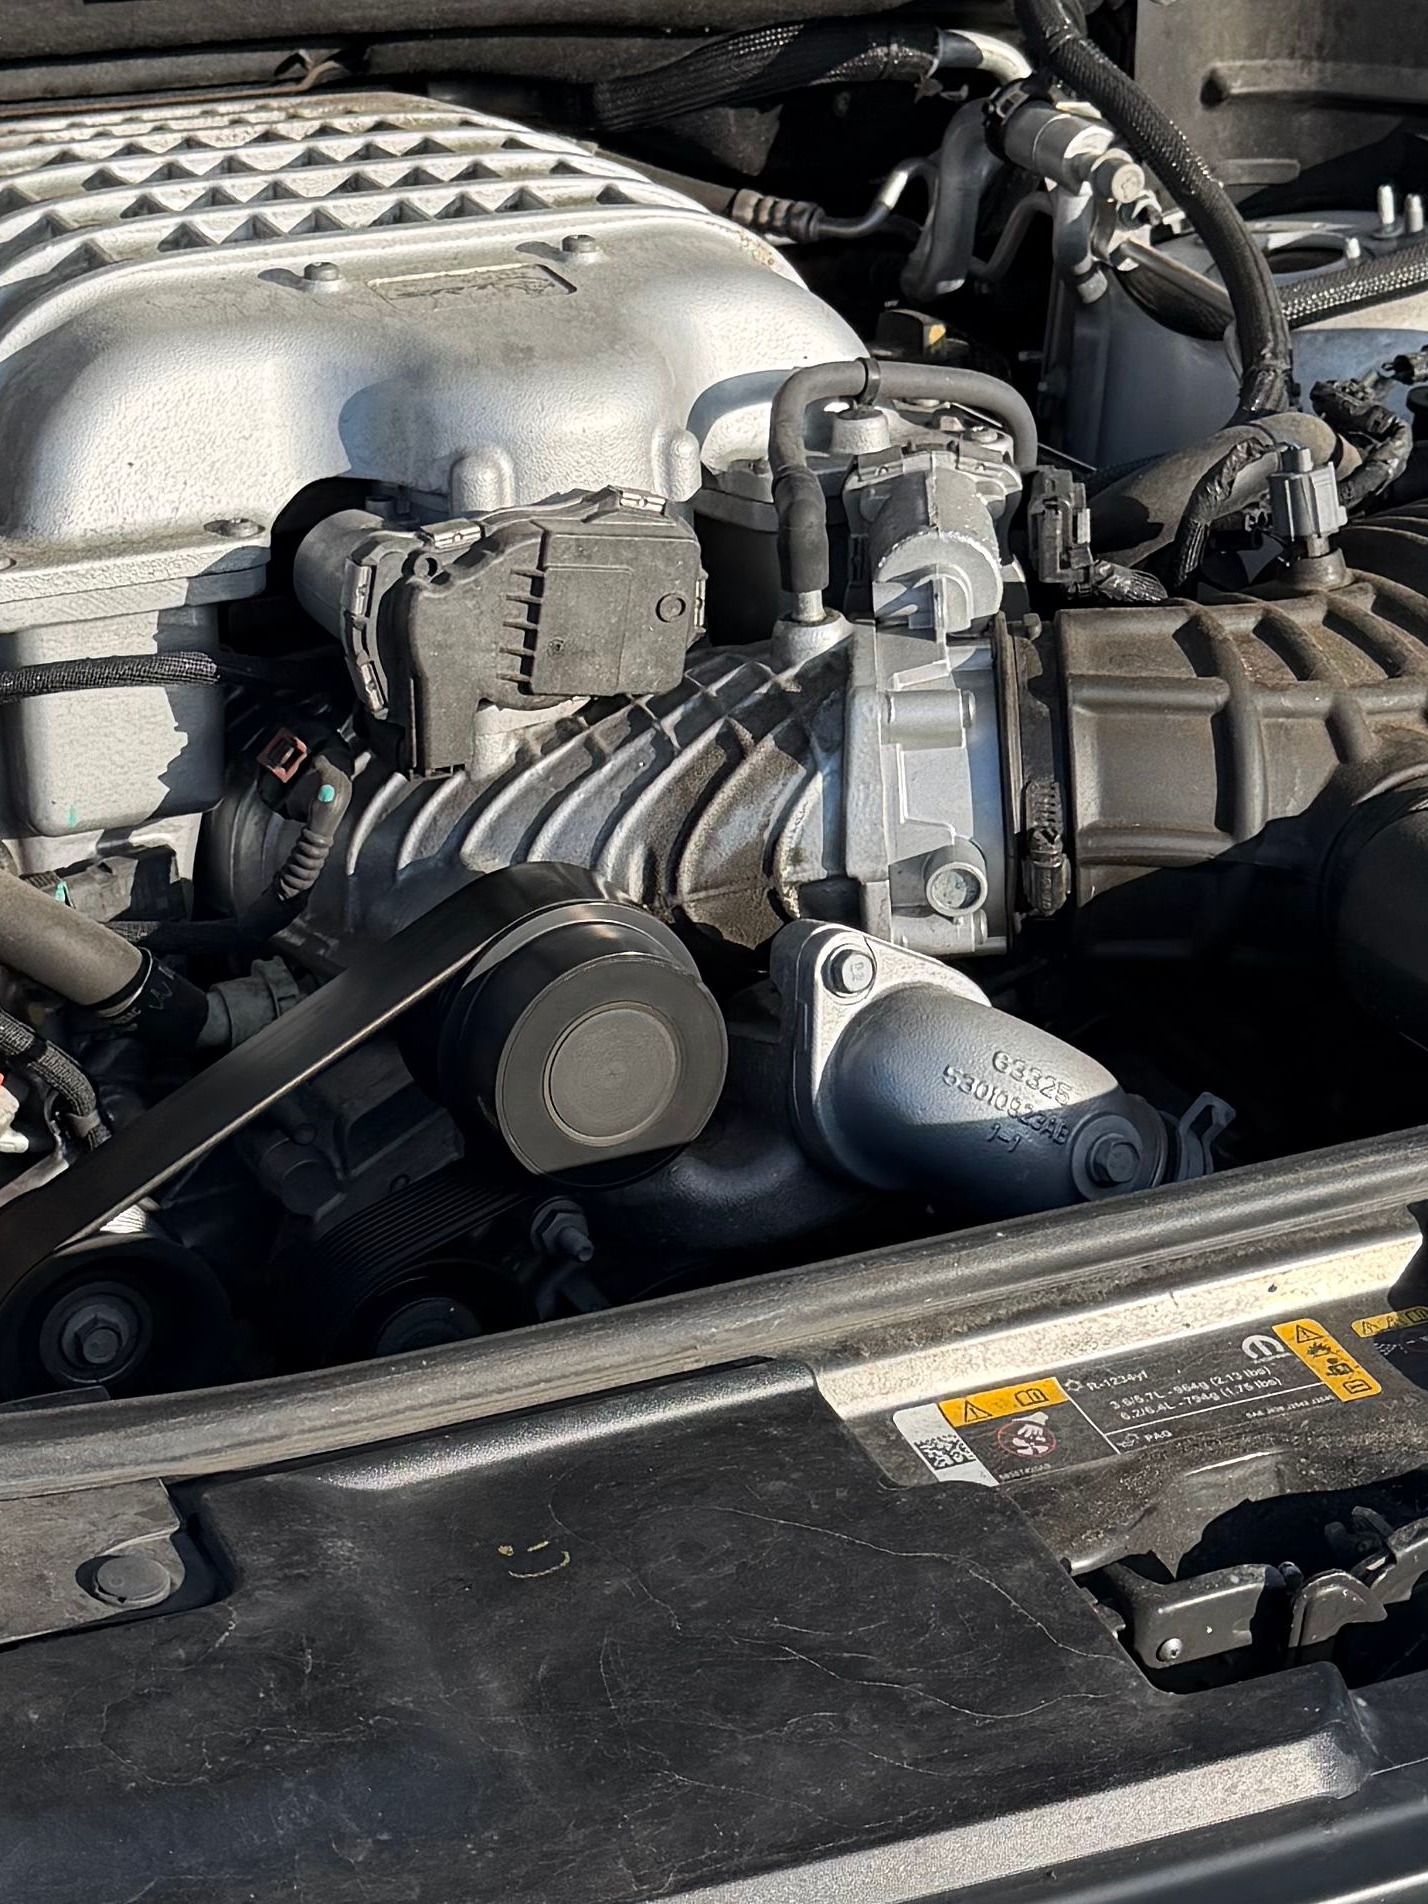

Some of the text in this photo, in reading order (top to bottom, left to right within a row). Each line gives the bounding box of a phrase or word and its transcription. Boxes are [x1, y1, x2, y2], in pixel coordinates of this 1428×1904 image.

[1210, 1373, 1241, 1389] (2.13
[1243, 1366, 1272, 1379] lbs)
[1221, 1383, 1253, 1400] (1.75
[1254, 1376, 1282, 1389] lbs)
